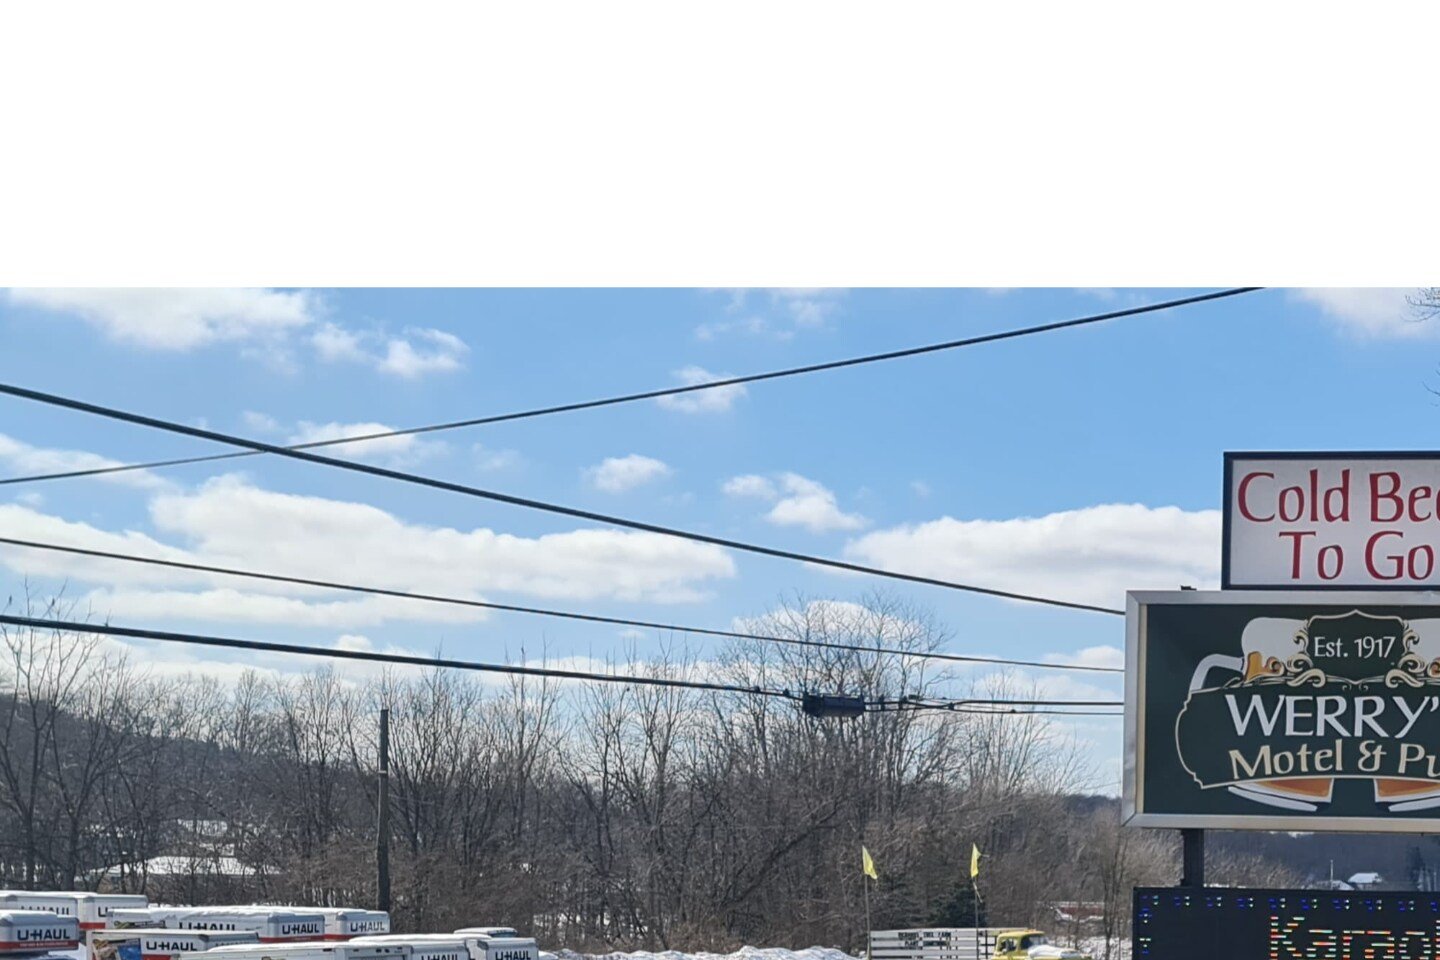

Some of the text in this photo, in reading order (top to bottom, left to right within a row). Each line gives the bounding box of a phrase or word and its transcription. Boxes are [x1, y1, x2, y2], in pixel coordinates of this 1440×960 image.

[1237, 469, 1350, 522] Cold
[1279, 530, 1435, 580] To Go
[1313, 636, 1396, 659] Est. 1917
[1228, 738, 1344, 779] Motel
[1358, 740, 1387, 772] &
[17, 928, 71, 941] U-HAUL
[281, 923, 320, 935] U-HAUL
[349, 920, 386, 933] U-HAUL
[145, 941, 198, 951] U-HAUL
